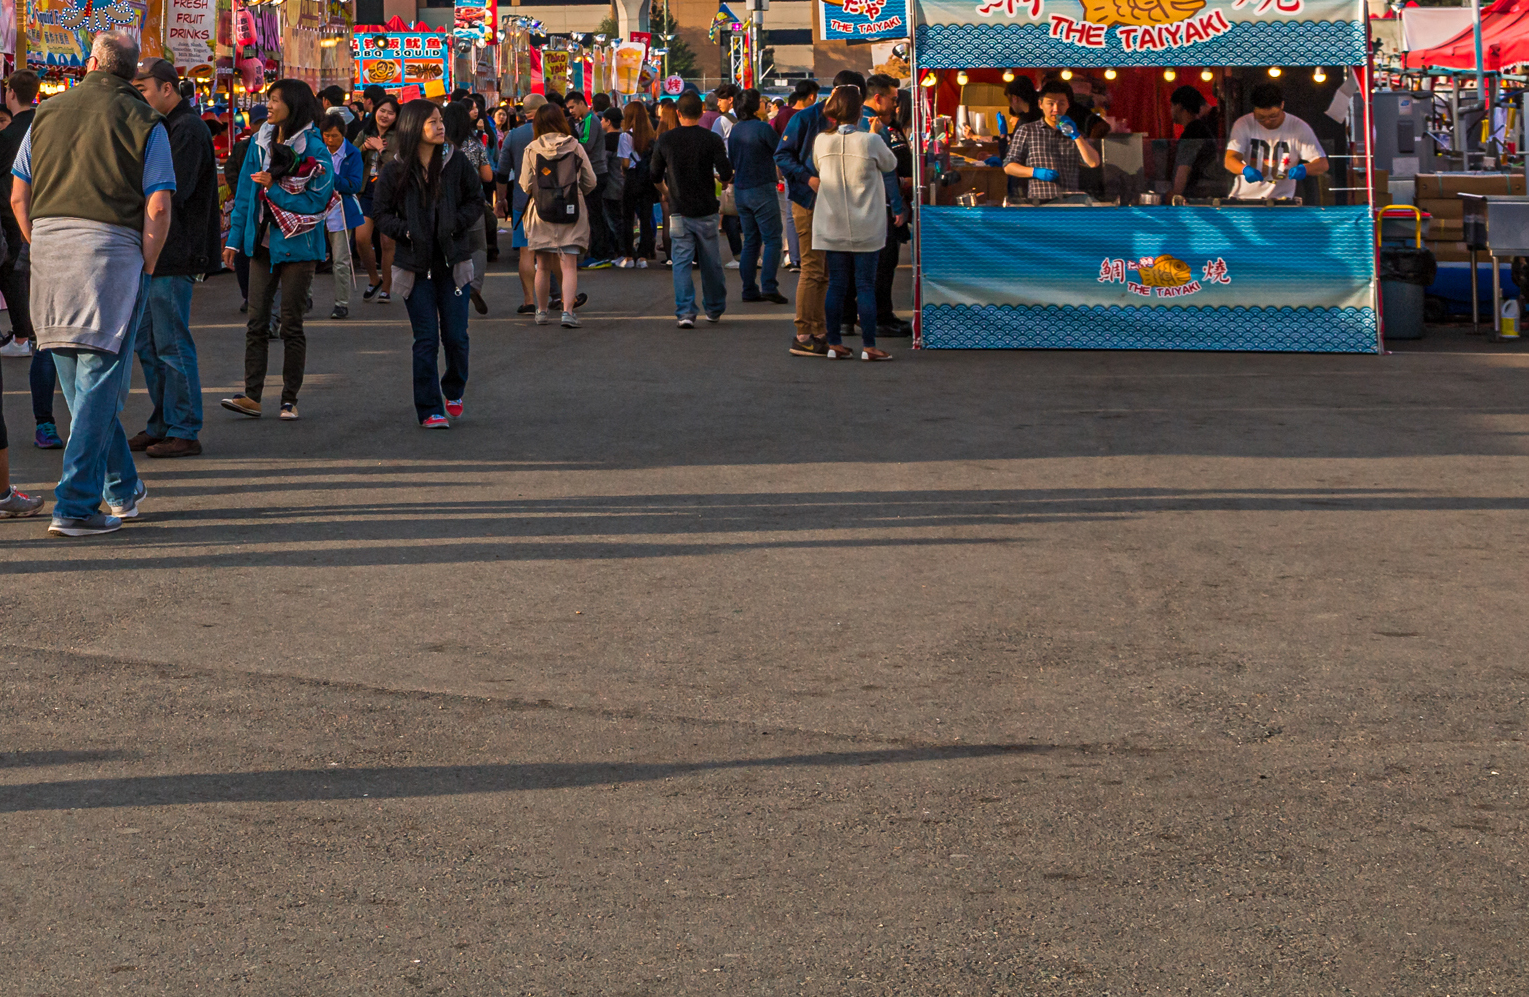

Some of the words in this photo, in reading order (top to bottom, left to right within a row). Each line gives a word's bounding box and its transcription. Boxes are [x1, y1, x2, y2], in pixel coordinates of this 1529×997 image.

[176, 13, 205, 24] FRUIT
[831, 20, 853, 34] THE
[858, 16, 902, 34] TAIYAKI
[170, 28, 210, 40] DRINKS
[1049, 12, 1108, 47] THE
[1118, 8, 1232, 51] TAIYAKI
[545, 53, 566, 63] Tako
[667, 78, 682, 92] 烤
[1127, 281, 1151, 296] THE
[1156, 280, 1202, 298] TAIYAKI
